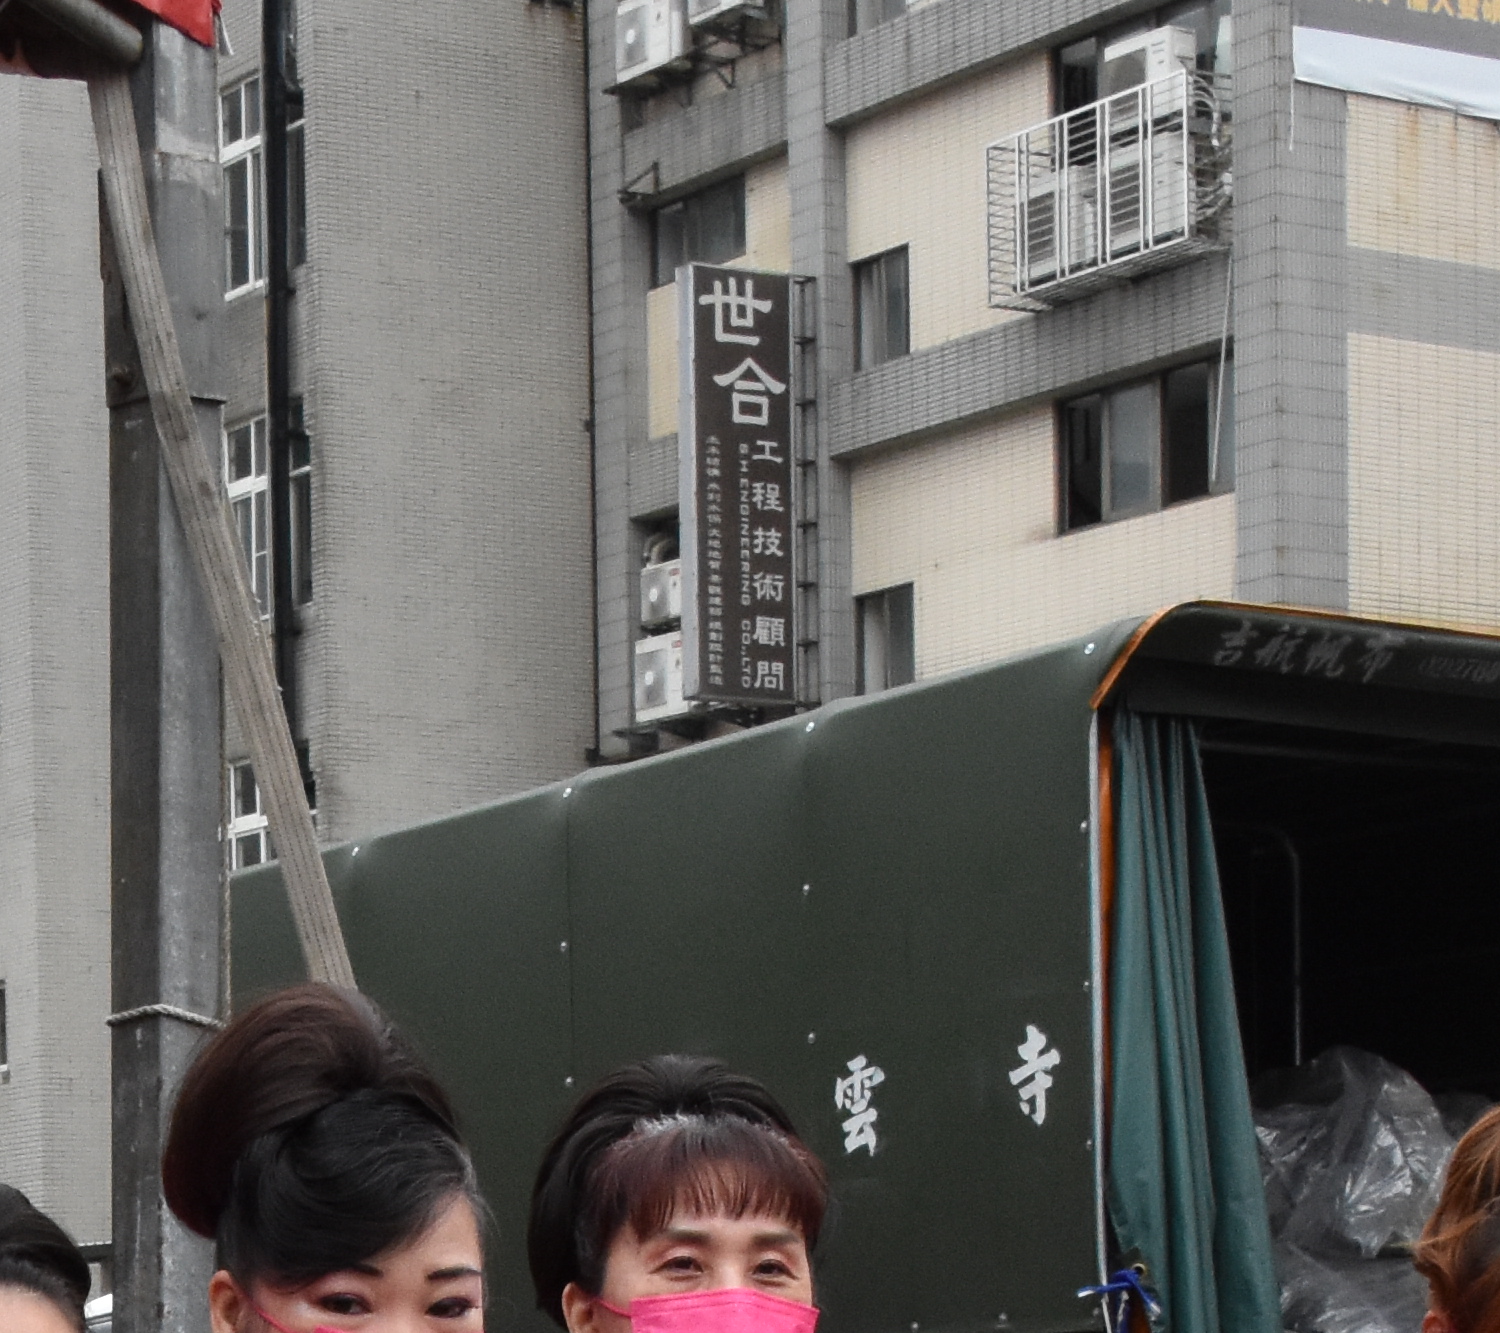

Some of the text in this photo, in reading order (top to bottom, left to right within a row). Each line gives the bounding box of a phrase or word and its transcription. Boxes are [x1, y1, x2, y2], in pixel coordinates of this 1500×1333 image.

[699, 277, 786, 426] 世合
[751, 440, 785, 691] 工程技術顧問
